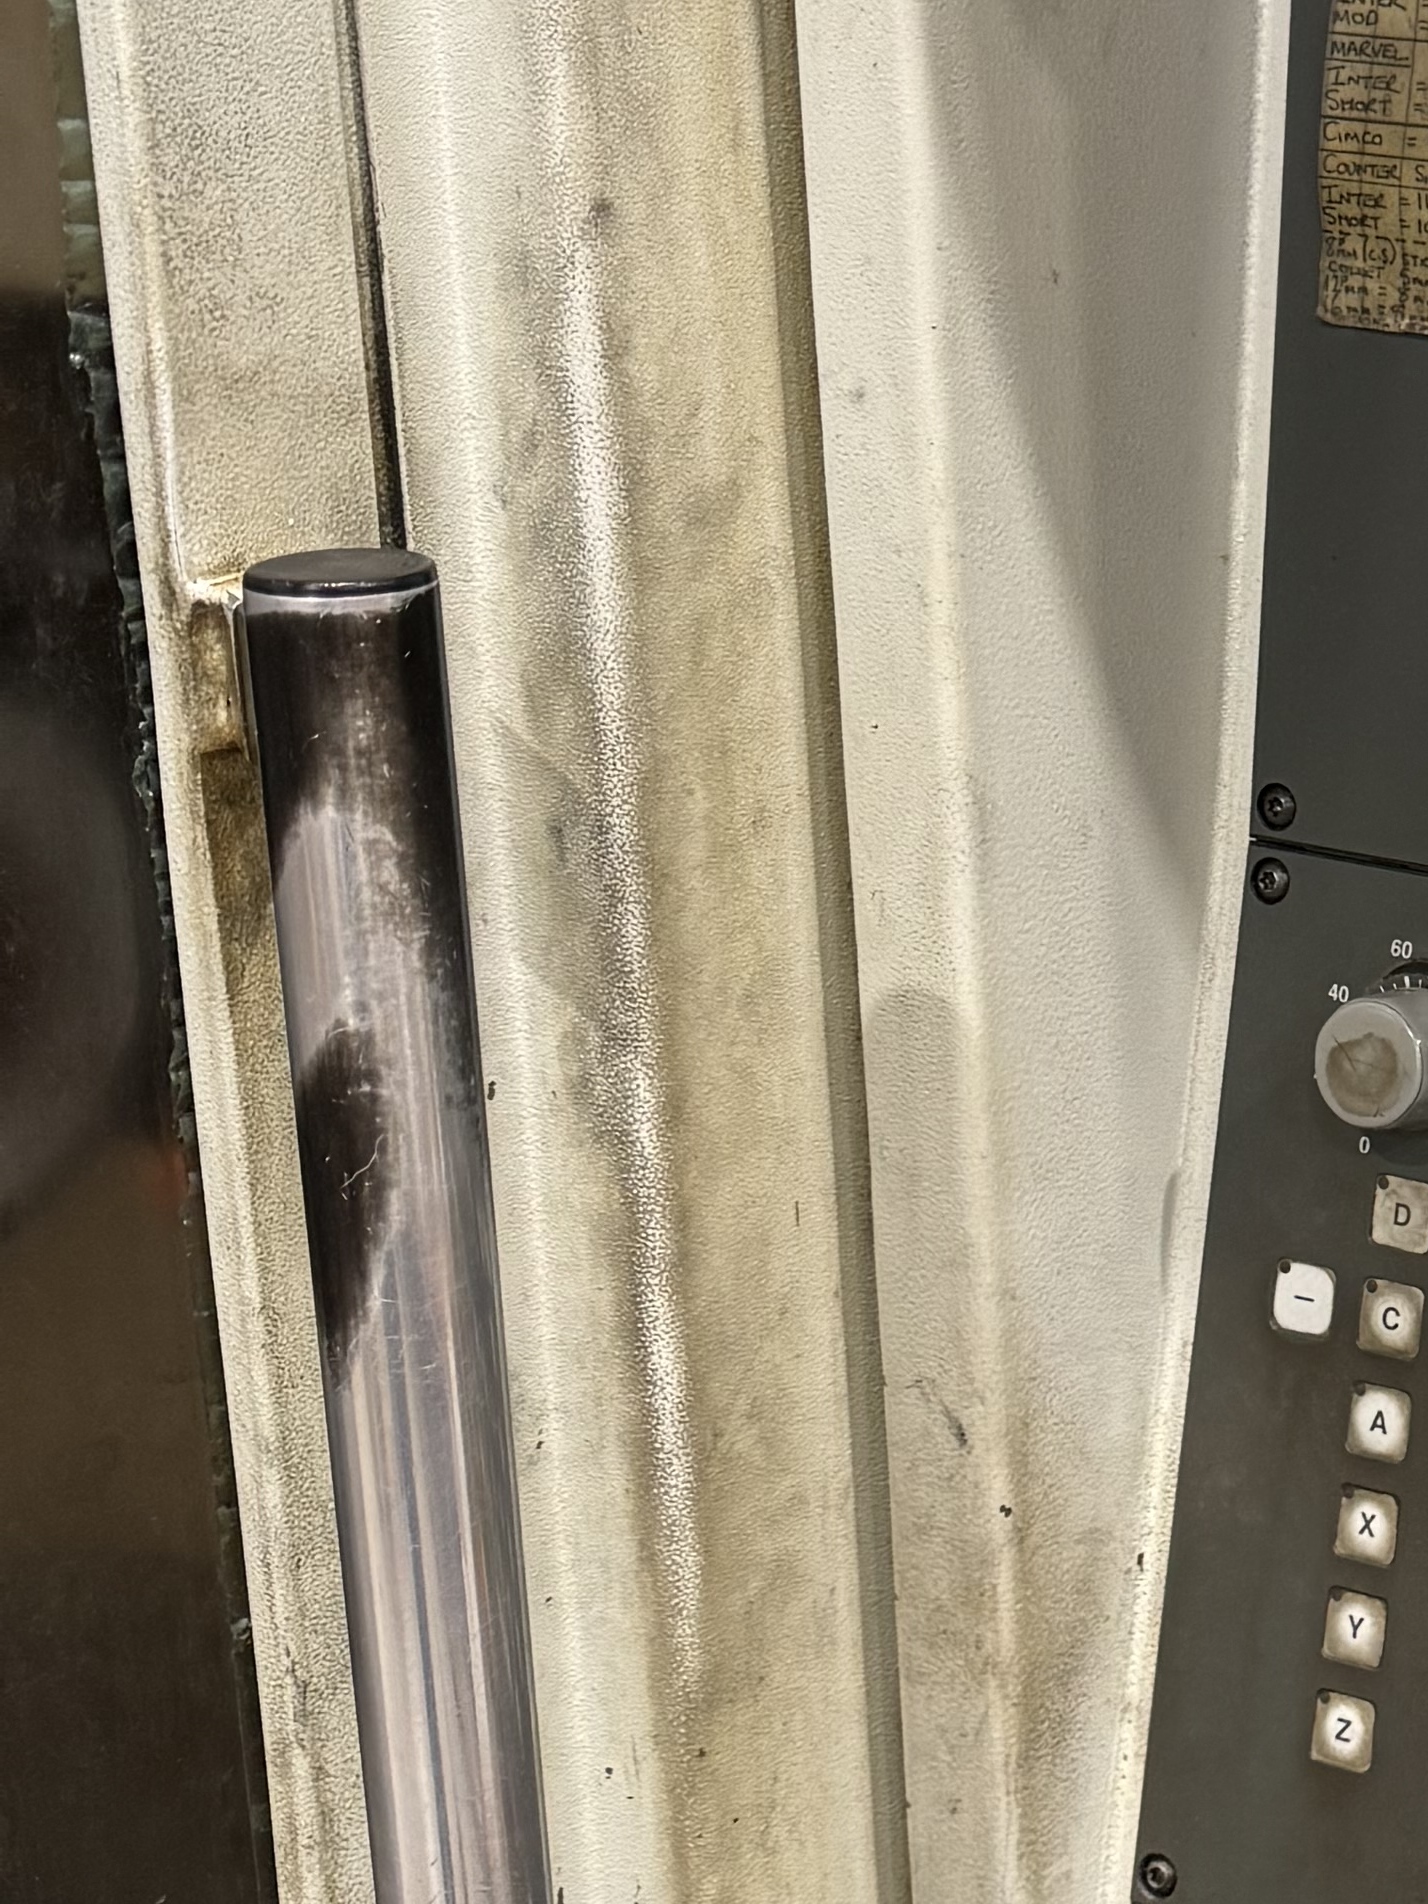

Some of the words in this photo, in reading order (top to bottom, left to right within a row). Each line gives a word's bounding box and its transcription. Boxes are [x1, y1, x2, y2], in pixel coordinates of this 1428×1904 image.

[1333, 10, 1379, 26] MOD
[1327, 66, 1401, 93] INTER
[1325, 90, 1391, 113] SHORT
[1323, 154, 1400, 181] COUNTER
[1321, 186, 1387, 209] INTER
[1323, 208, 1380, 230] SHORT
[1390, 939, 1413, 959] 60
[1328, 983, 1350, 1003] 40
